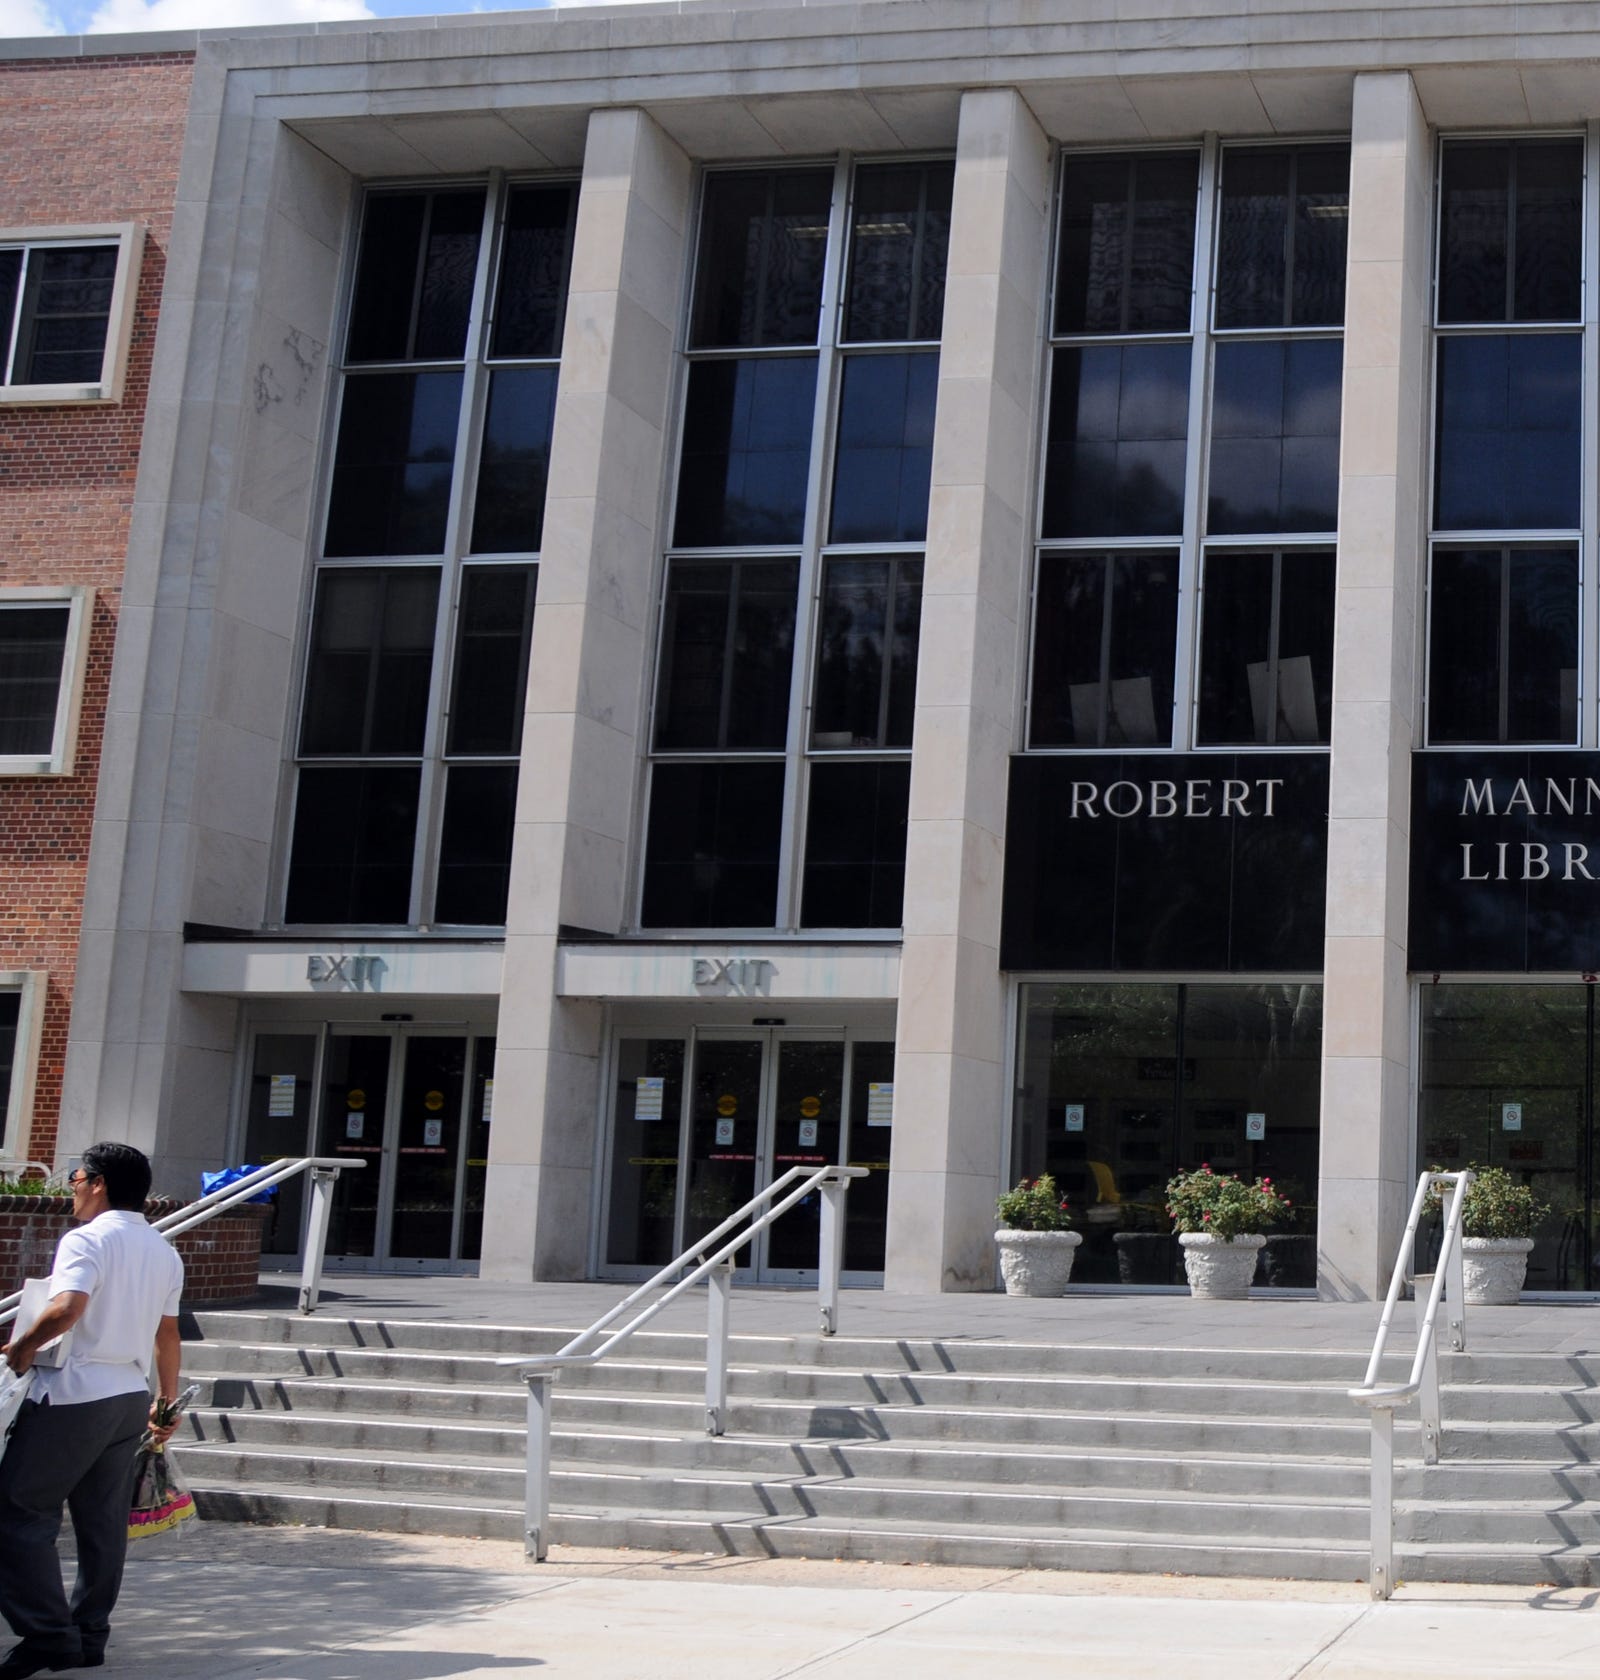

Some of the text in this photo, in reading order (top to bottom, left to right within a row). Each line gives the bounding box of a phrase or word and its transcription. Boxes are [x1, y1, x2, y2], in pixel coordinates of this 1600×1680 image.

[1069, 779, 1284, 818] ROBERT
[306, 955, 382, 982] EXIT
[691, 959, 770, 986] EXIT
